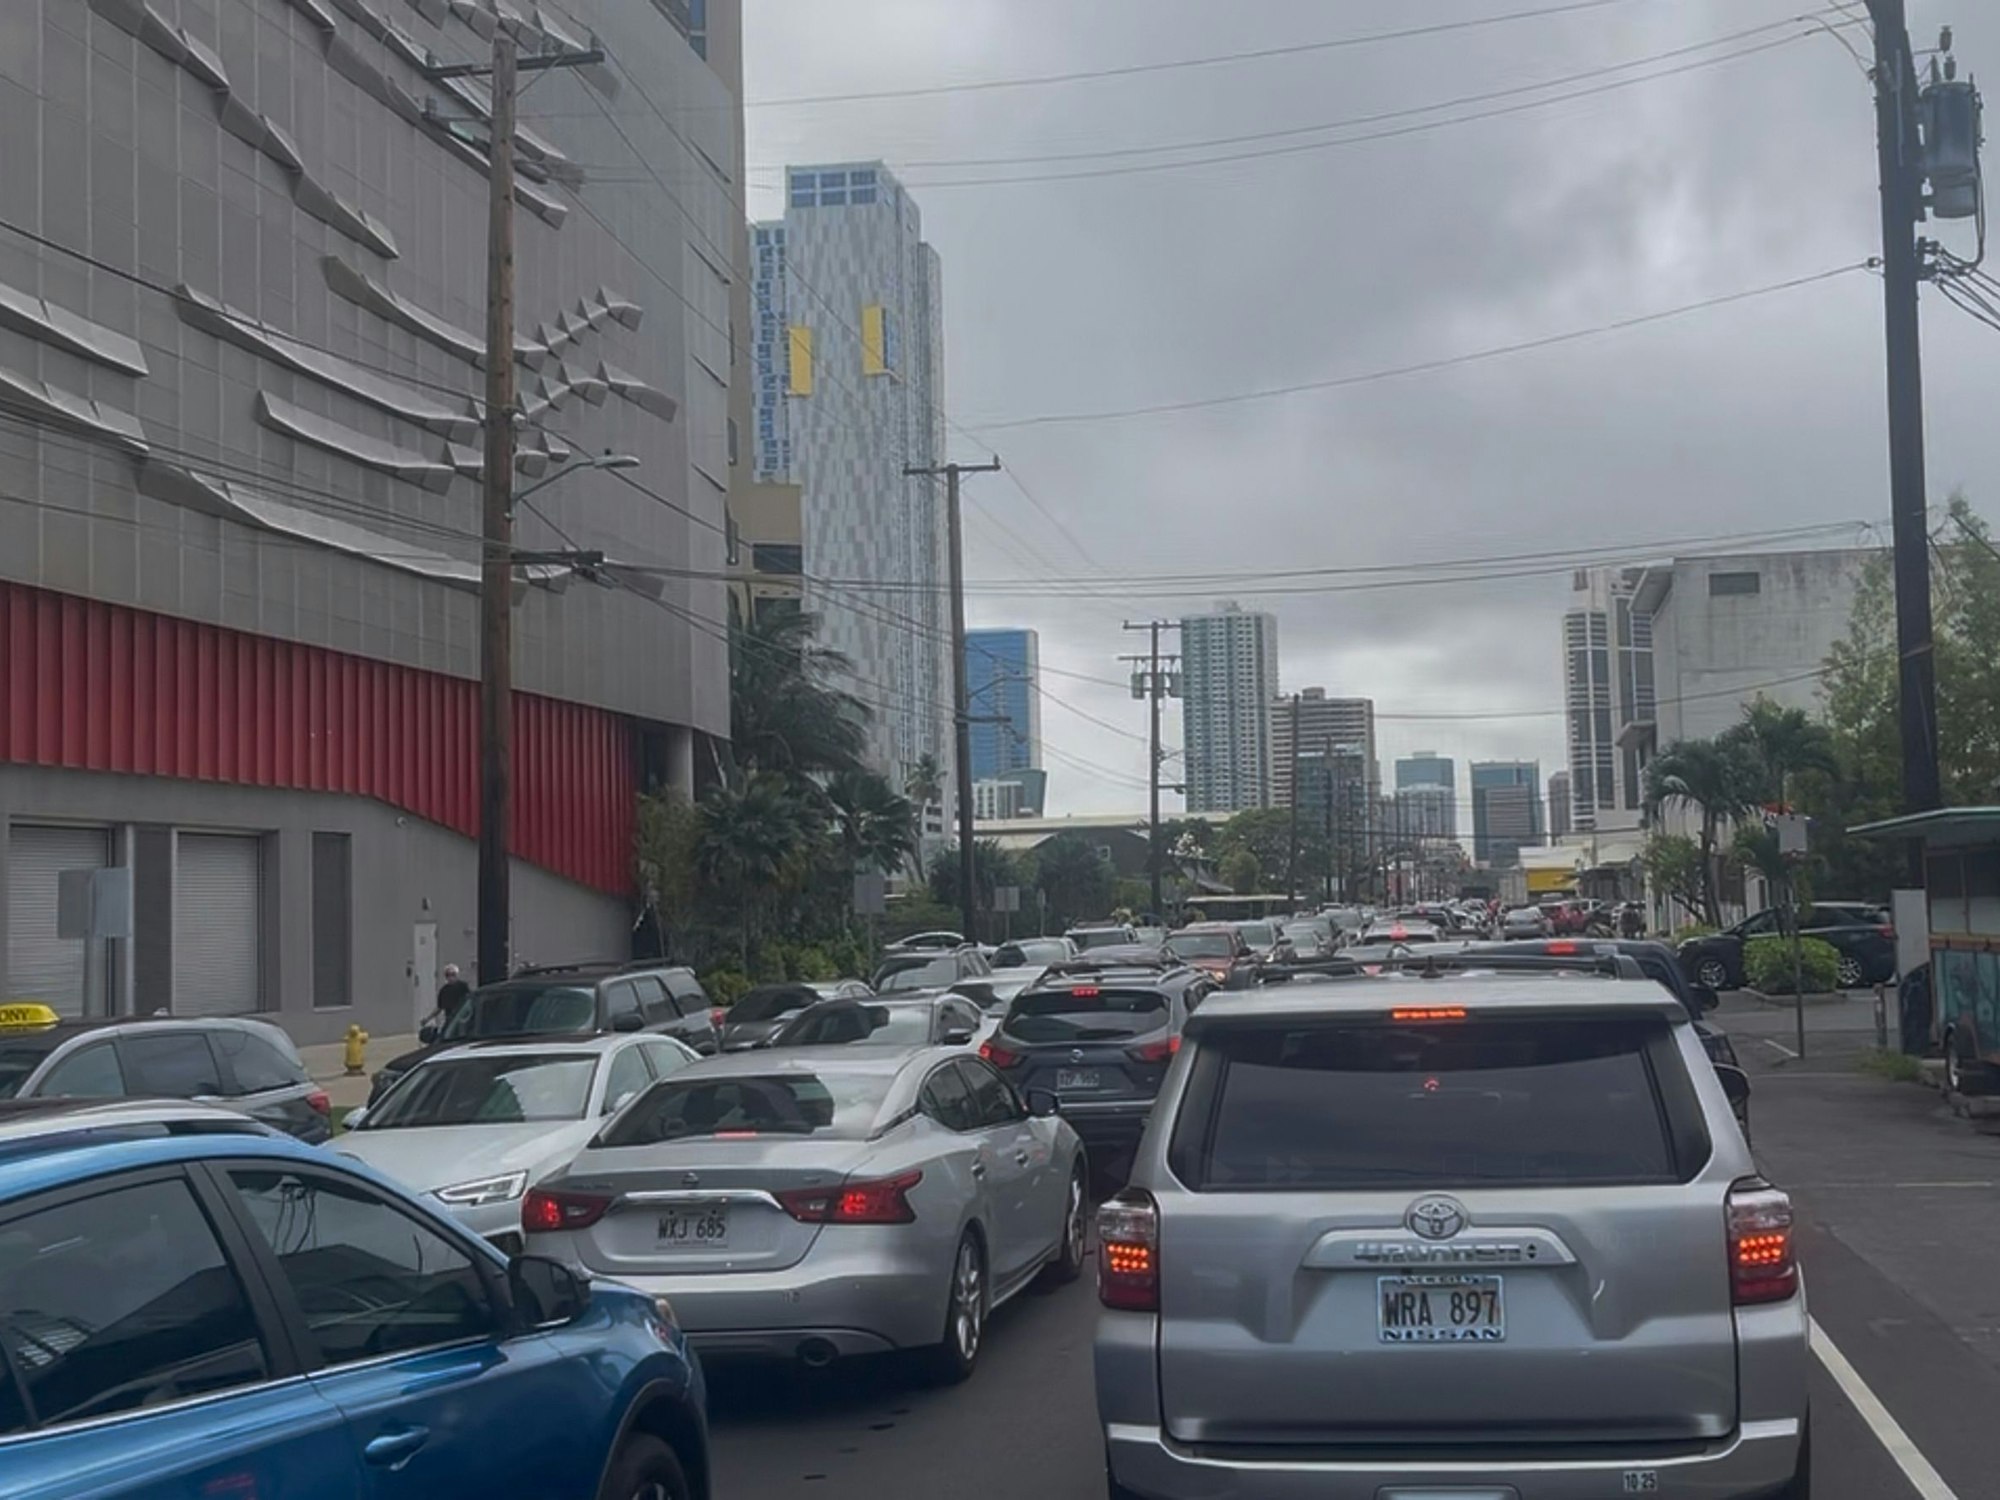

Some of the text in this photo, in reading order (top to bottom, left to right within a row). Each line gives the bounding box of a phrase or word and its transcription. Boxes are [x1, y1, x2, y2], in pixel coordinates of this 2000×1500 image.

[658, 1217, 726, 1239] WXJ 685
[1385, 1291, 1497, 1326] WRA 897
[1382, 1328, 1501, 1340] NISSAN
